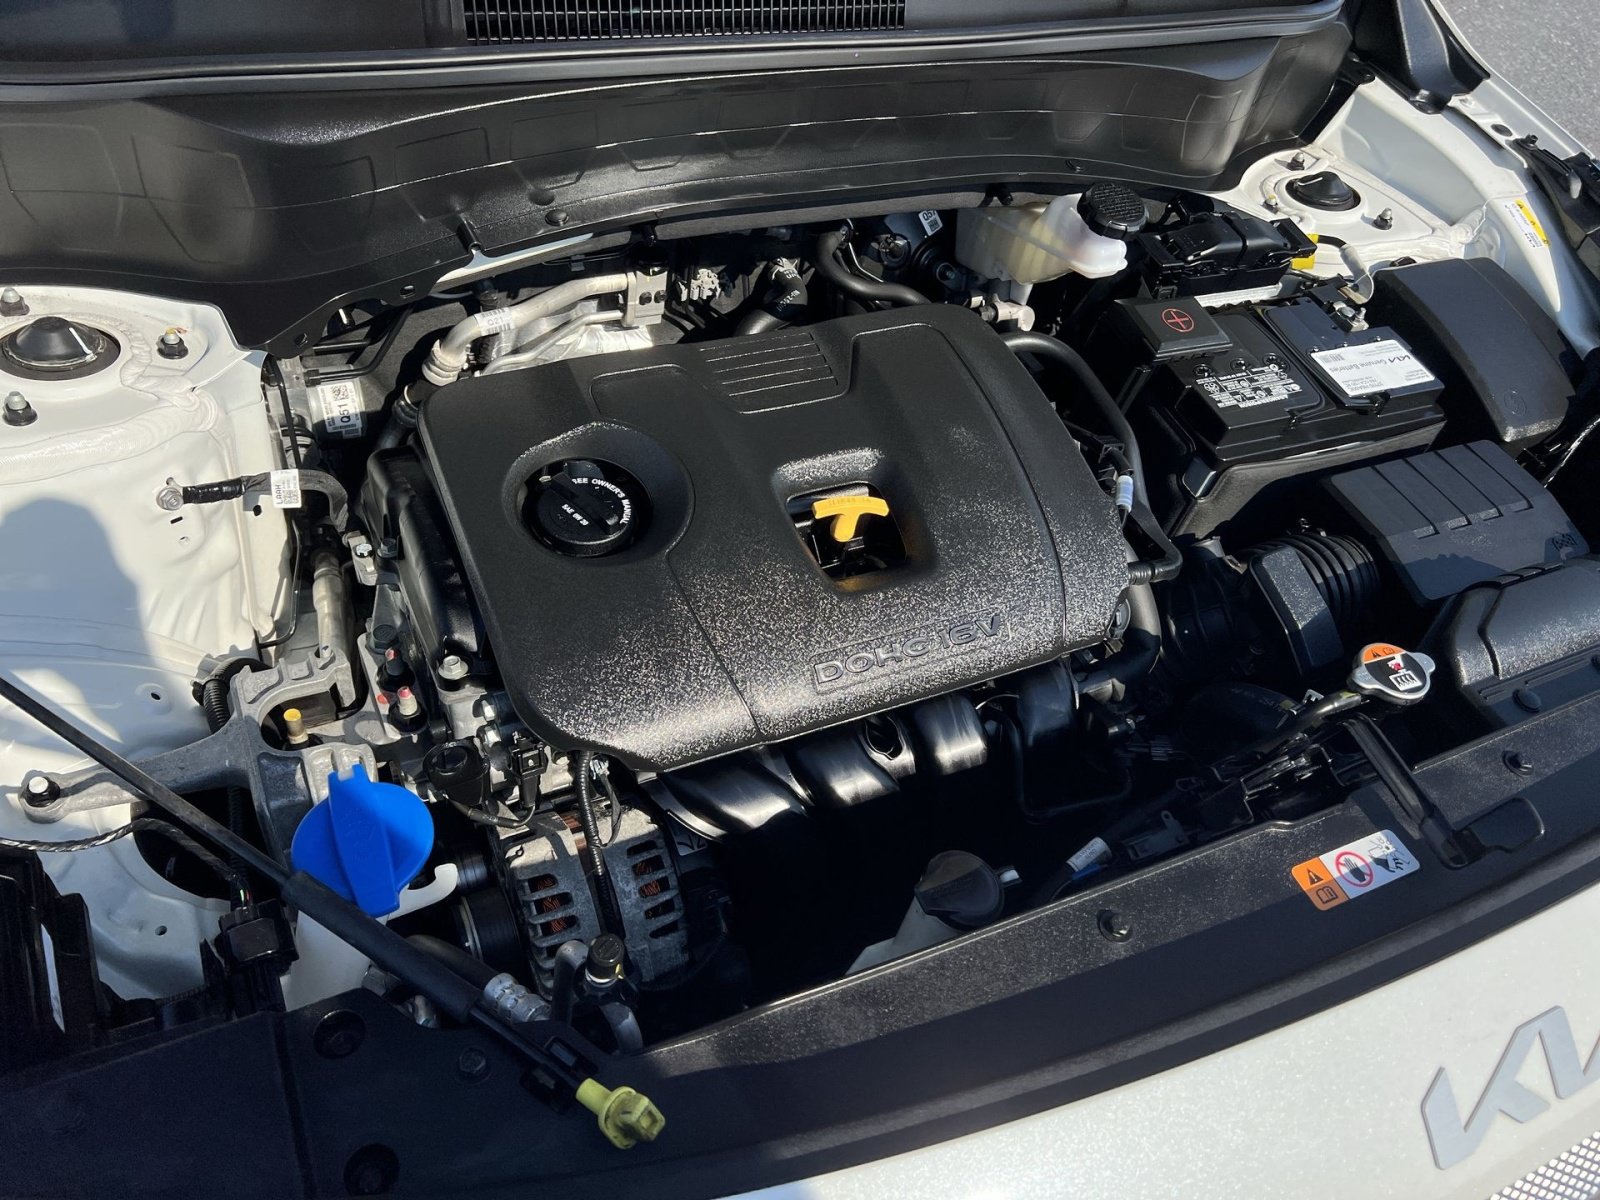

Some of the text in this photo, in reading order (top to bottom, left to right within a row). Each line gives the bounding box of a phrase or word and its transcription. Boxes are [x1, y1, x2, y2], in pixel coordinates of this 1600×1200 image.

[1329, 363, 1360, 373] Batteries
[1387, 354, 1411, 363] KIA
[338, 403, 351, 424] Q51
[592, 478, 626, 498] OWNER'S
[620, 499, 631, 524] MANUAL
[814, 615, 1001, 684] DOHC 16V
[1420, 1005, 1600, 1171] KI
